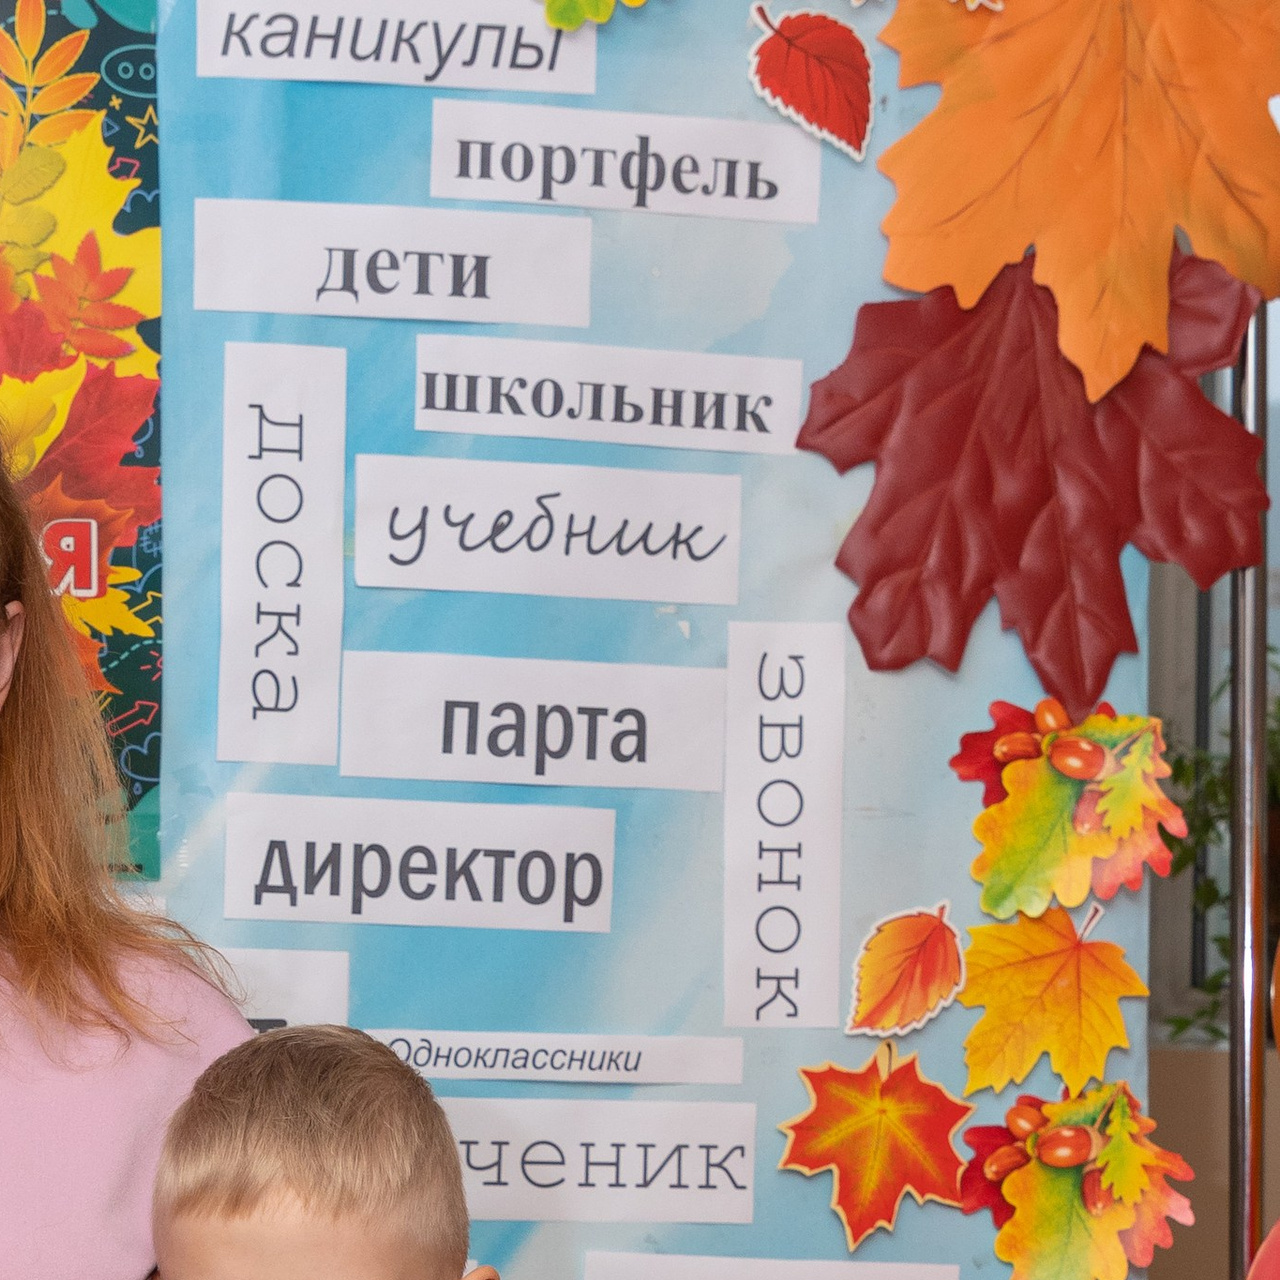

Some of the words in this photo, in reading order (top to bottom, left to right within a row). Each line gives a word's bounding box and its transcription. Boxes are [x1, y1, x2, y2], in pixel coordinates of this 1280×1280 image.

[220, 12, 565, 82] каникулы
[455, 135, 780, 206] портфель
[316, 247, 492, 302] дети
[421, 371, 774, 435] школьник
[248, 403, 305, 722] доска
[388, 491, 727, 567] учебник
[441, 698, 648, 776] парта
[757, 653, 806, 1022] звонок
[254, 837, 604, 923] директор
[388, 1037, 642, 1072] Одноклассники
[459, 1140, 747, 1190] ченик
